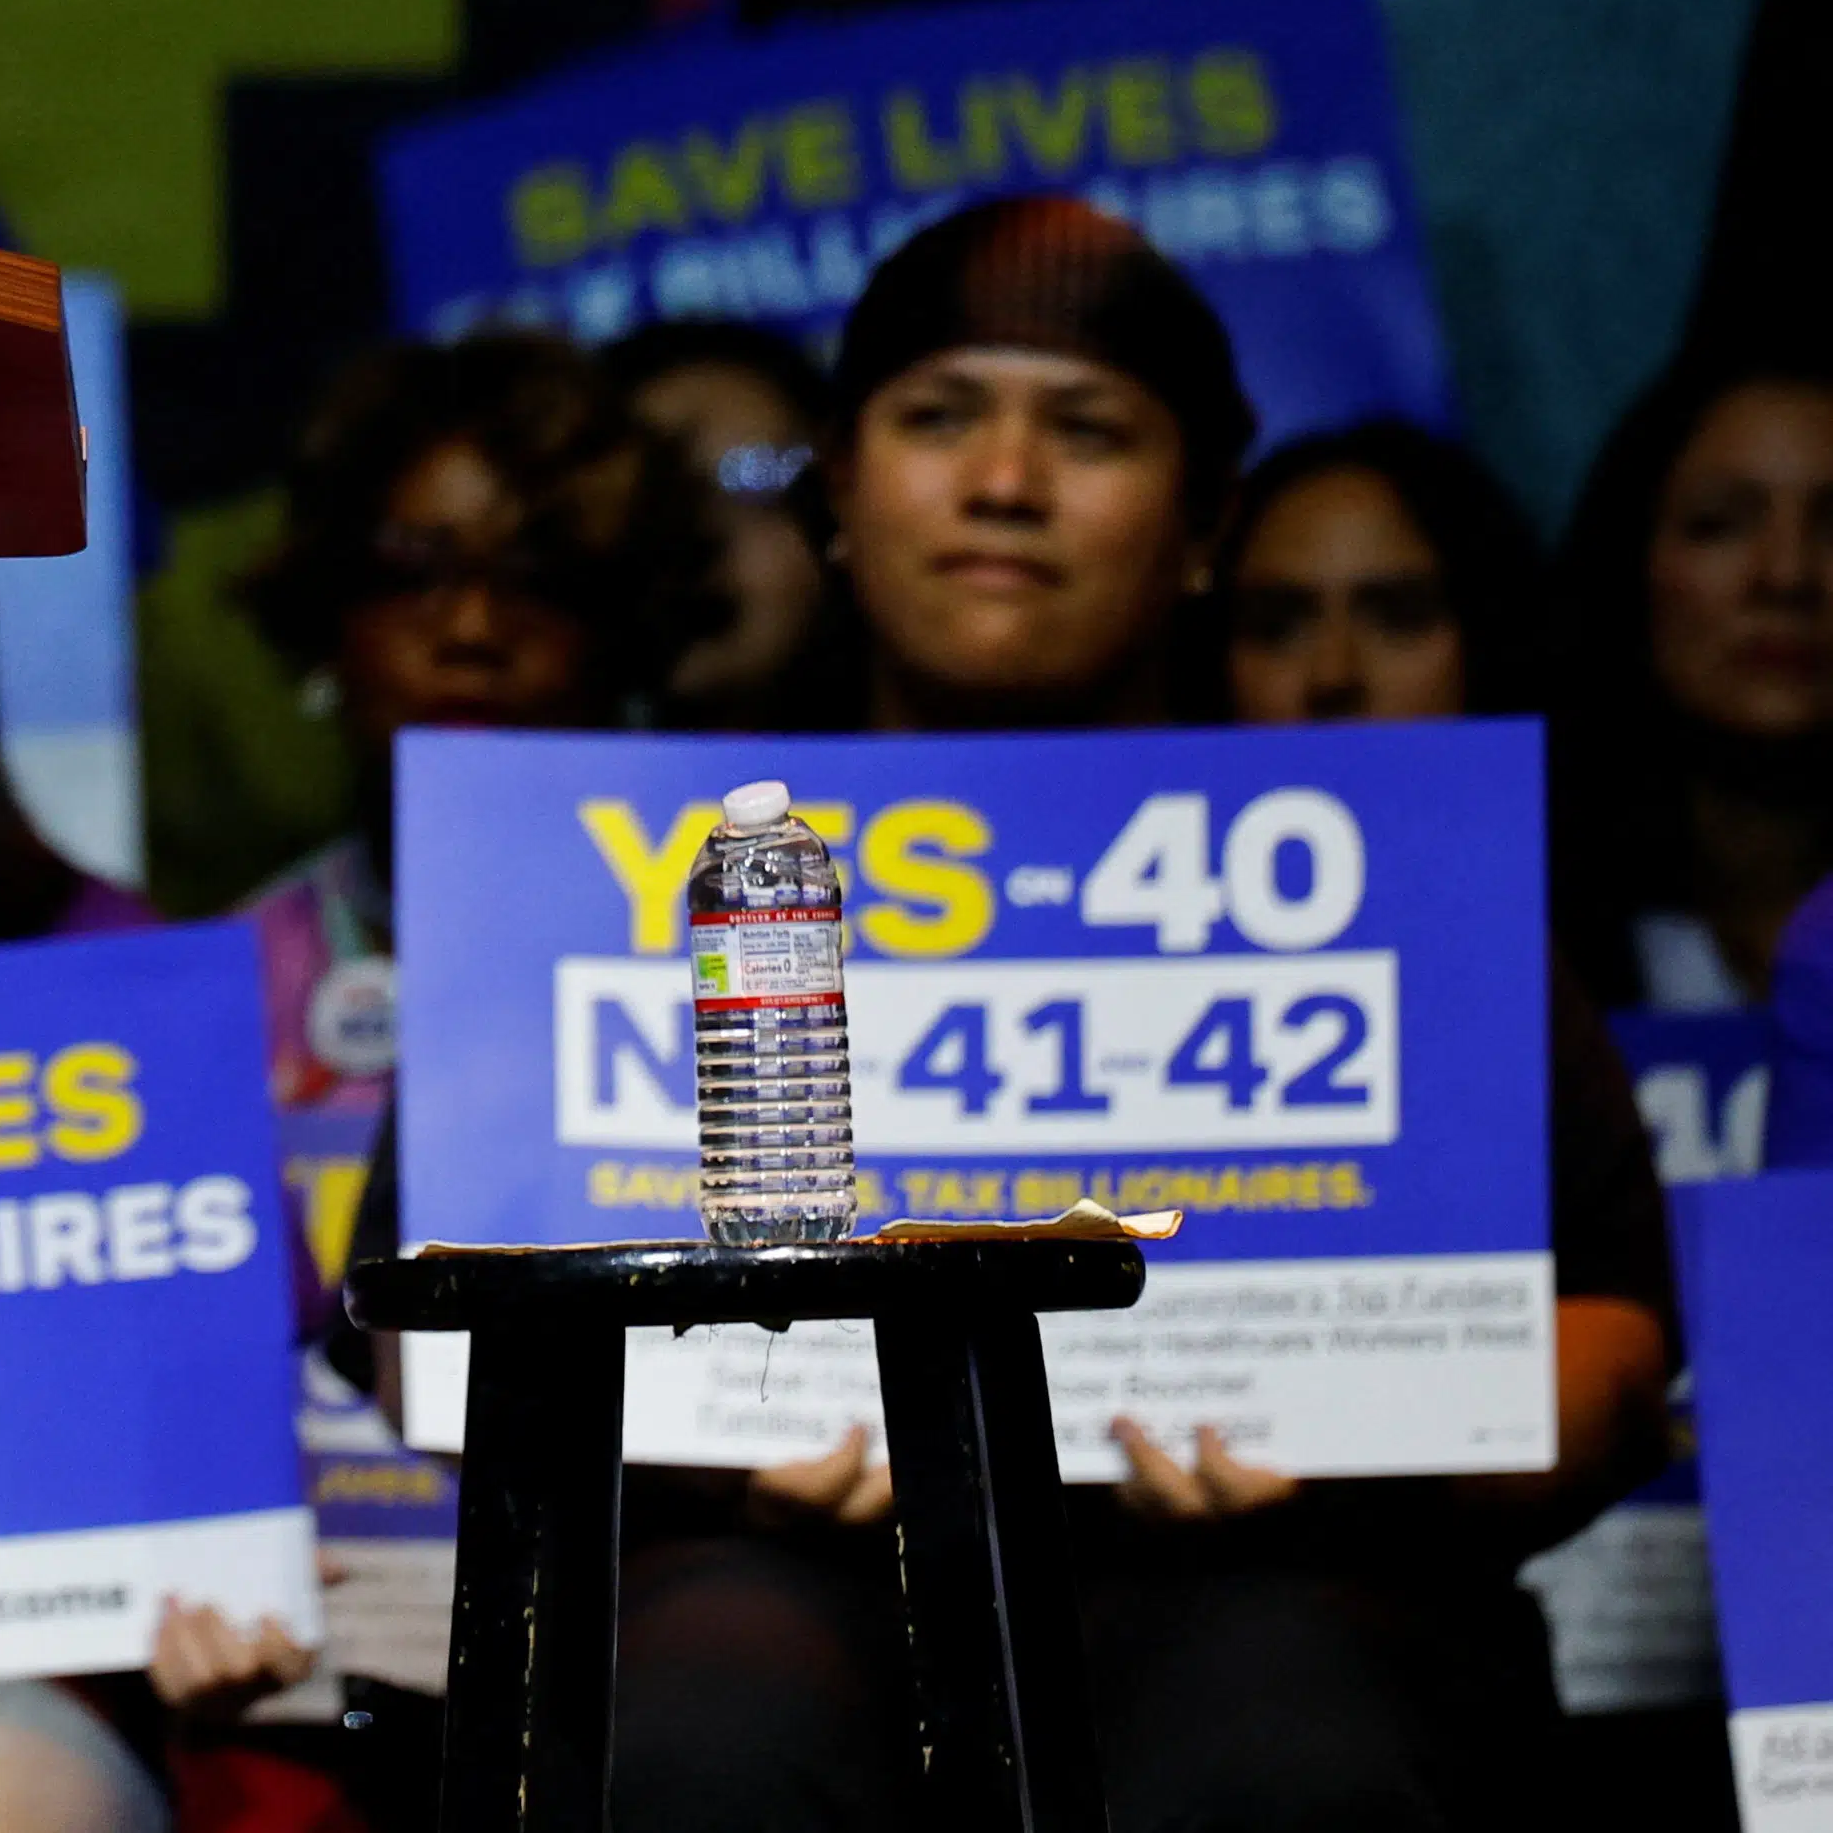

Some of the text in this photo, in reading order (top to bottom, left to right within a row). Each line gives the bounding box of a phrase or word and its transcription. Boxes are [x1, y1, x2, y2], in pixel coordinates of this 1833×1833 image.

[509, 47, 1275, 265] SAVE LIVES
[578, 799, 995, 958] YS
[1080, 785, 1367, 953] 40
[784, 958, 791, 973] 0
[593, 993, 1370, 1119] N 41 42
[588, 1162, 699, 1206] SAV
[900, 1168, 1001, 1216] TAX
